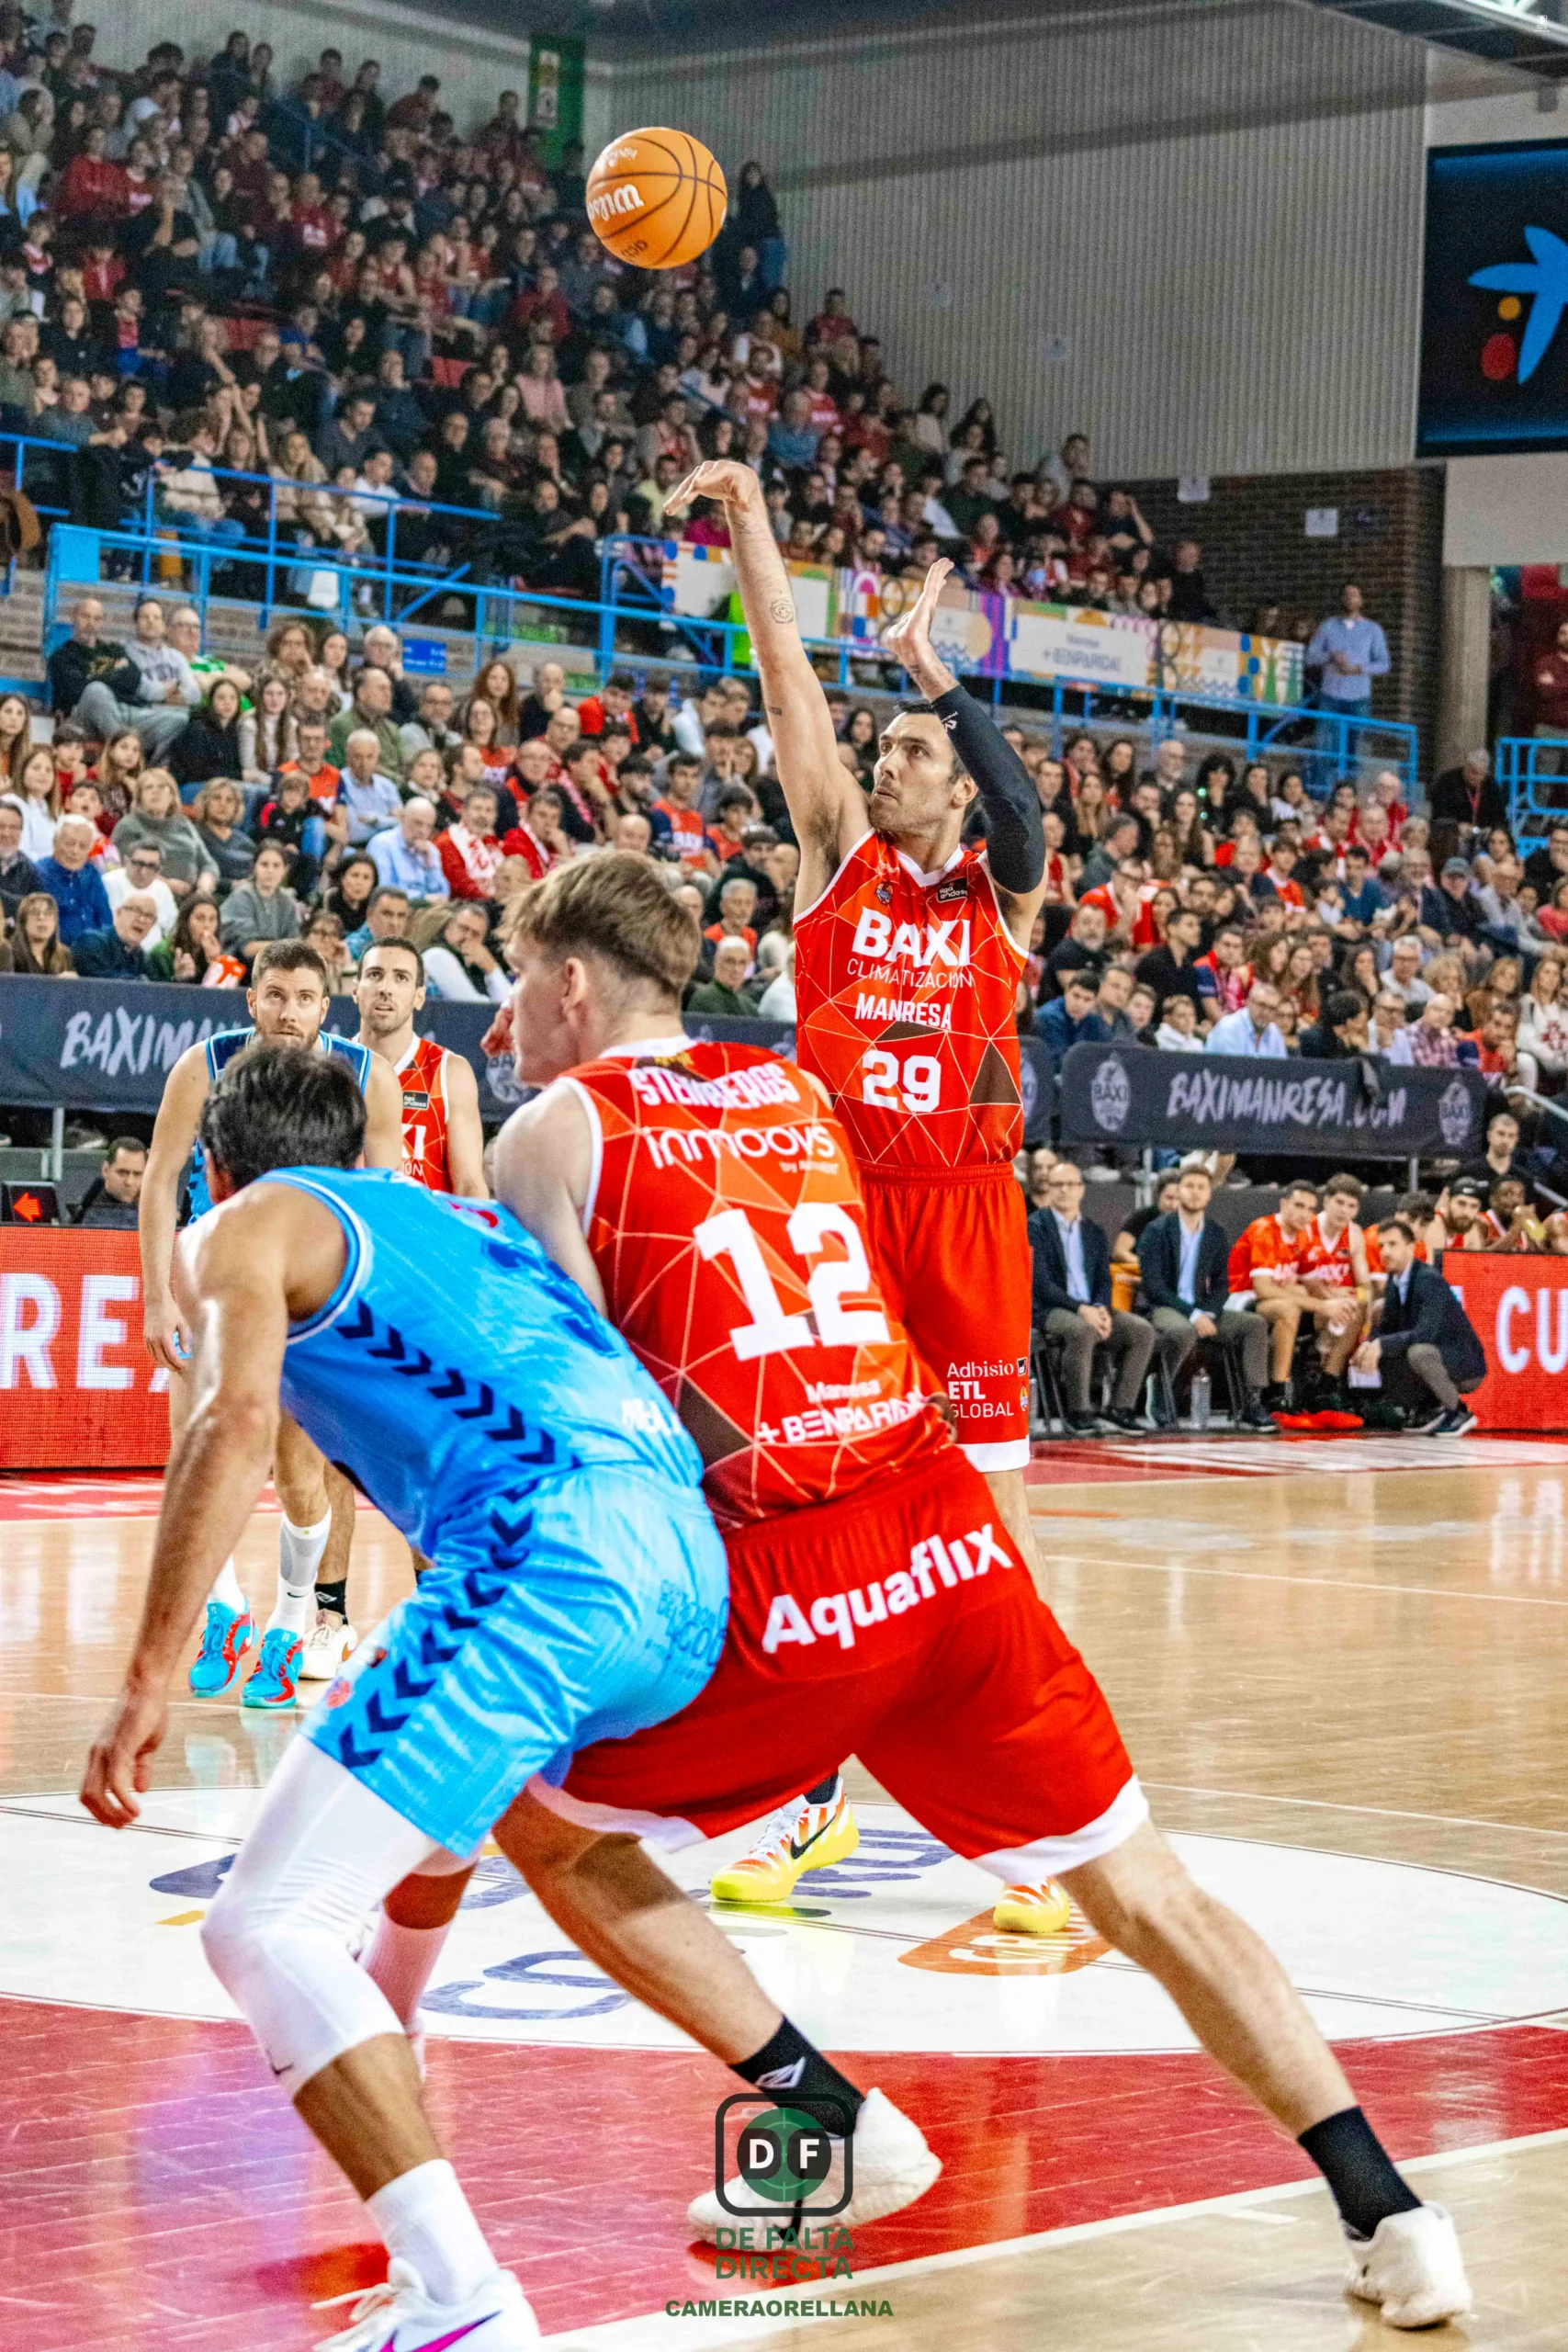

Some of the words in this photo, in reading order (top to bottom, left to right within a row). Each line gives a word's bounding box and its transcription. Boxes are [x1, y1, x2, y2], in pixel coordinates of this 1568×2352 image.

[852, 906, 971, 967] BAXI
[854, 992, 952, 1031] MANRESA
[862, 1048, 942, 1114] 29
[643, 1125, 837, 1170] inmoovs
[693, 1201, 890, 1362] 12
[946, 1360, 1015, 1378] Adbisio
[947, 1380, 986, 1400] ETL
[761, 1522, 1014, 1654] Aquaflix
